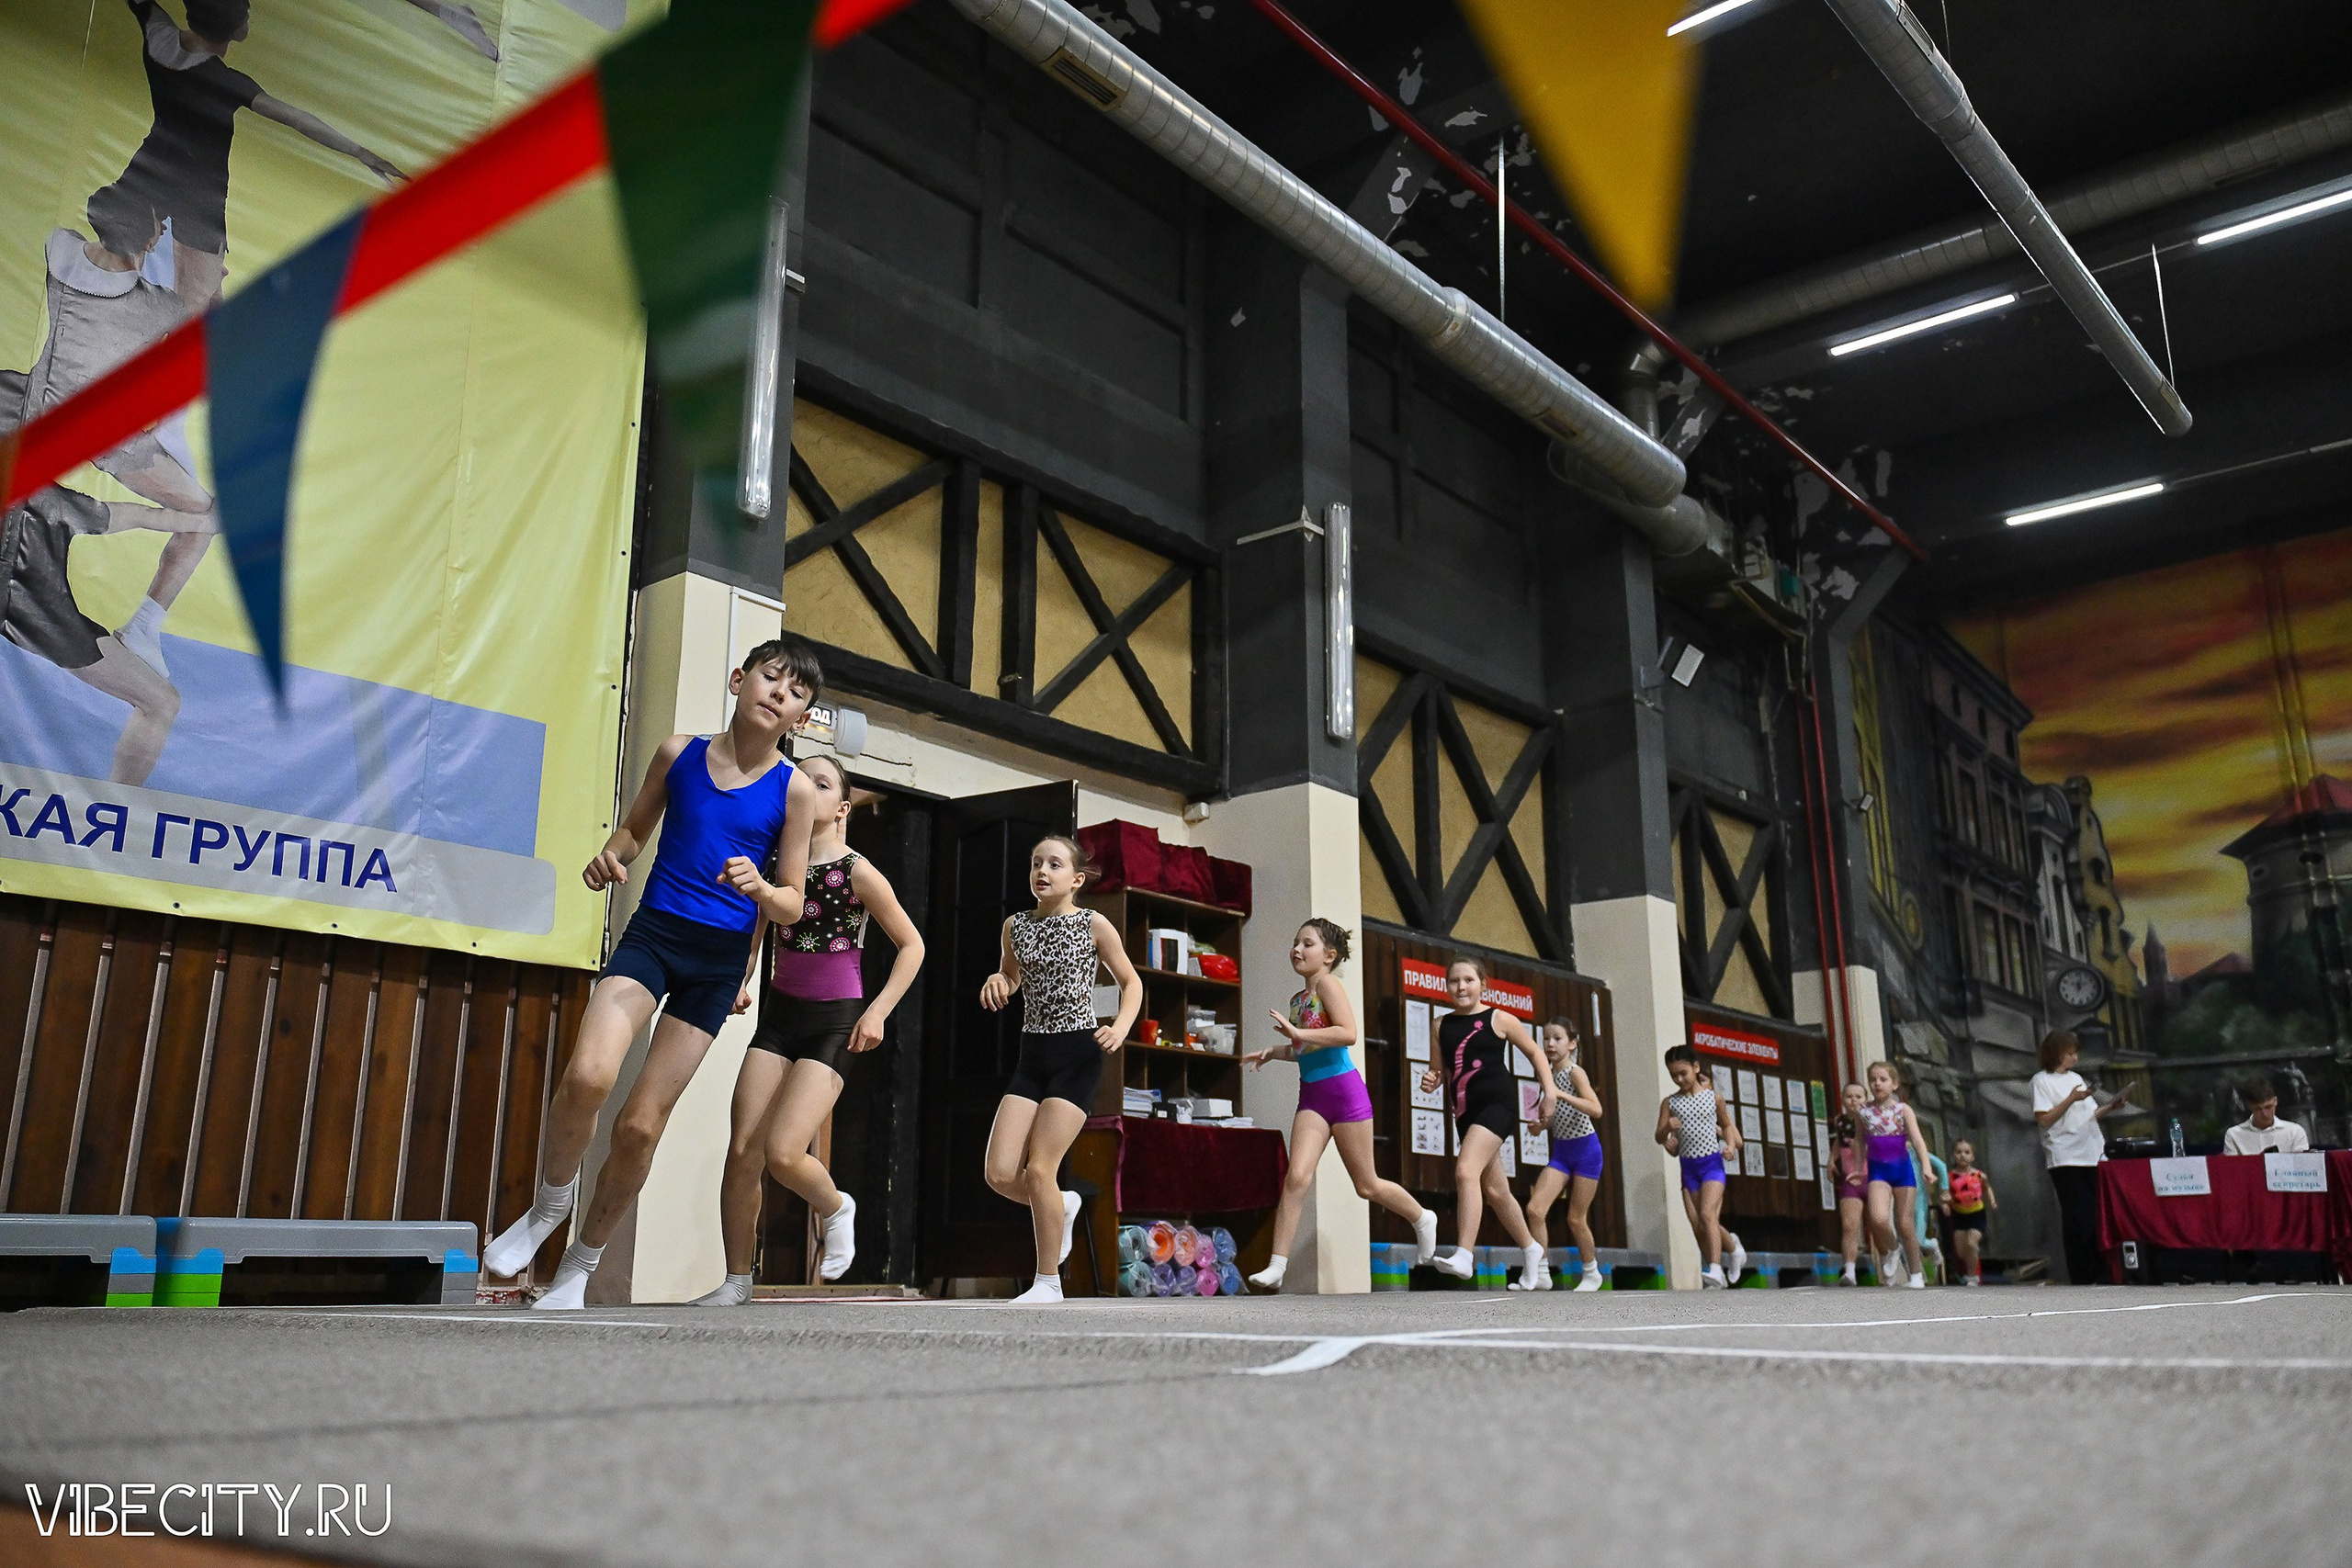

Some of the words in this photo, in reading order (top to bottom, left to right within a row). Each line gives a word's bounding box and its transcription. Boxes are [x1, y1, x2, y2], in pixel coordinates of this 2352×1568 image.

[151, 812, 398, 893] ГРУППА
[1404, 969, 1447, 992] ПРАВИЛ
[1481, 990, 1533, 1011] ВНОВАНИЙ
